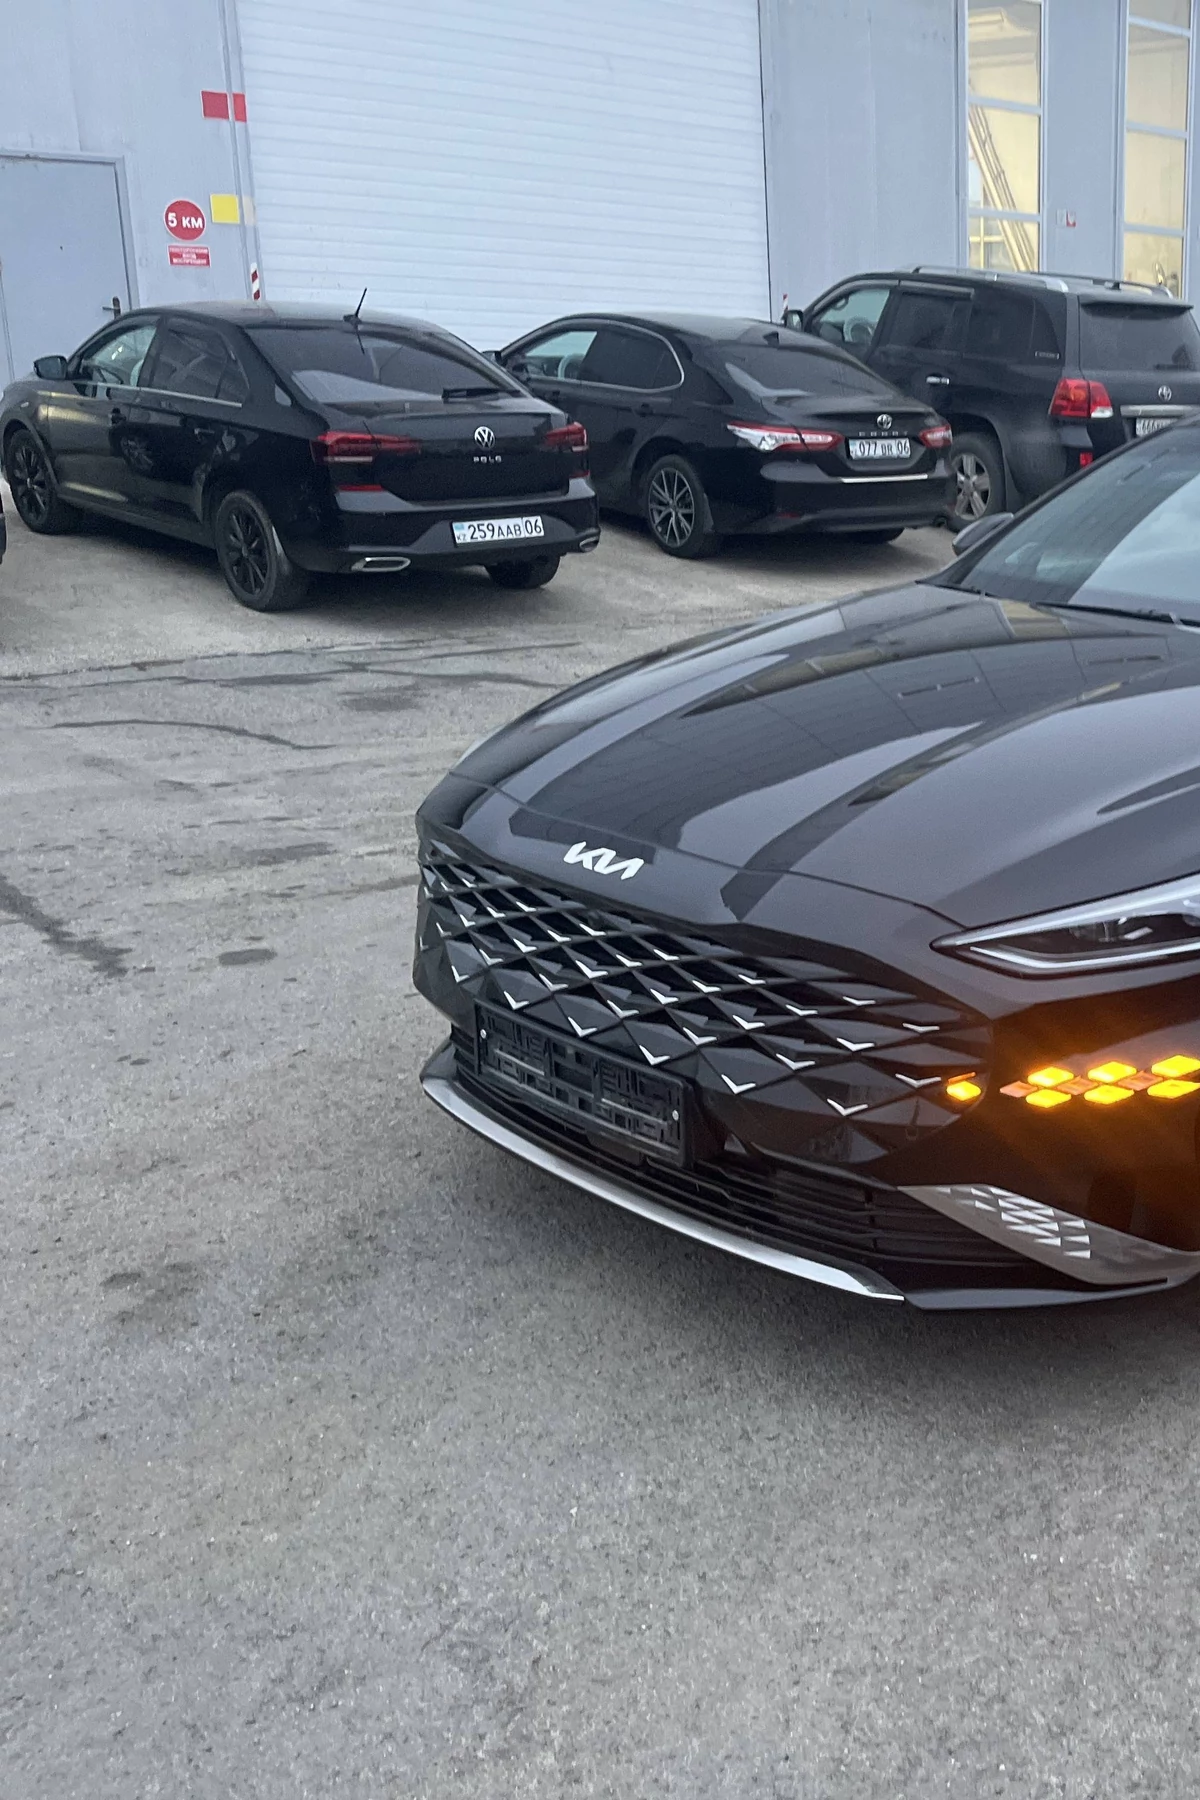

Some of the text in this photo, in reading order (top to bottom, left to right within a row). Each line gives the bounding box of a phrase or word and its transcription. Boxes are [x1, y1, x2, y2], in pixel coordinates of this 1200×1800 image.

[167, 212, 177, 227] 5
[897, 440, 910, 455] 06
[524, 519, 542, 535] 06
[563, 841, 644, 880] KIA
